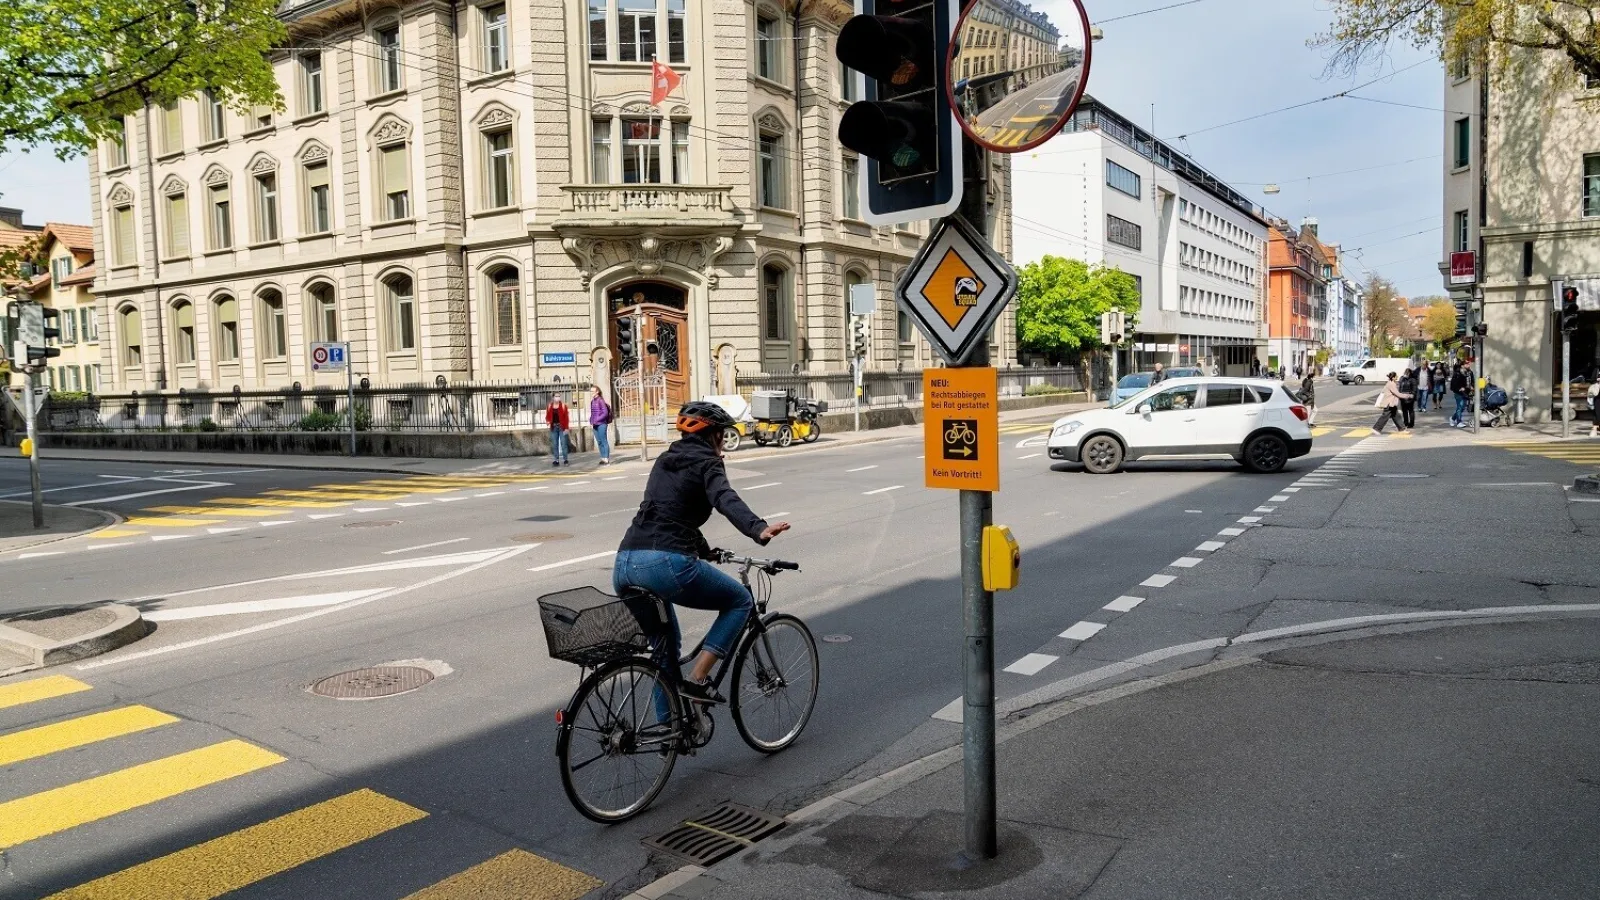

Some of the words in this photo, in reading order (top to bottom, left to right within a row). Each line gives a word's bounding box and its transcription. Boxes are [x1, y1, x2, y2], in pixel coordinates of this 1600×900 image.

[930, 379, 950, 388] NEU:
[930, 390, 986, 401] Rechtsabbiegen
[931, 401, 942, 409] bei
[943, 401, 956, 409] Rot
[957, 402, 990, 411] gestattet
[932, 469, 949, 477] Kein
[950, 469, 983, 479] Vortritt!
